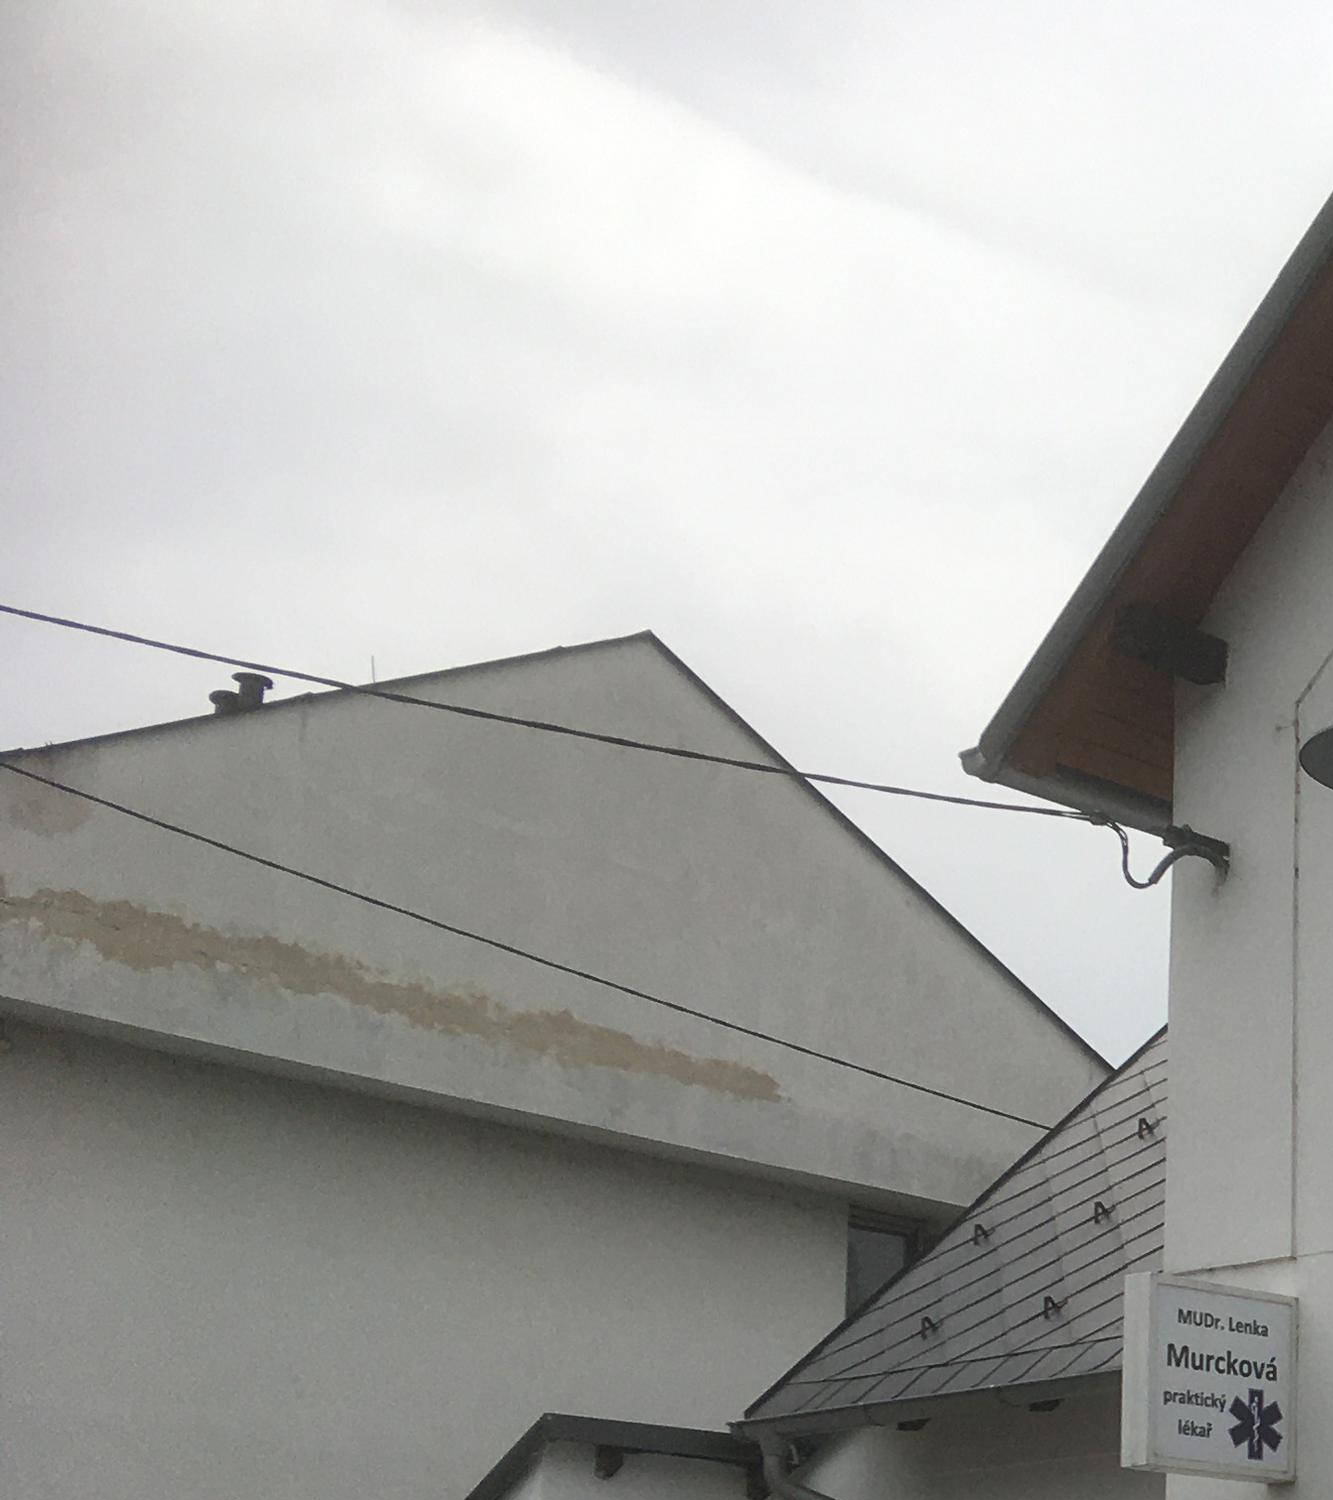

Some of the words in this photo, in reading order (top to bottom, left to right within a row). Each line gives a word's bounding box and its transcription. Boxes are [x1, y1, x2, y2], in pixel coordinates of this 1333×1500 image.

[1177, 1308, 1225, 1331] MUDr.
[1228, 1316, 1269, 1337] Lenka
[1166, 1343, 1278, 1381] Murcková
[1163, 1389, 1227, 1413] praktický
[1178, 1419, 1213, 1438] lékař
